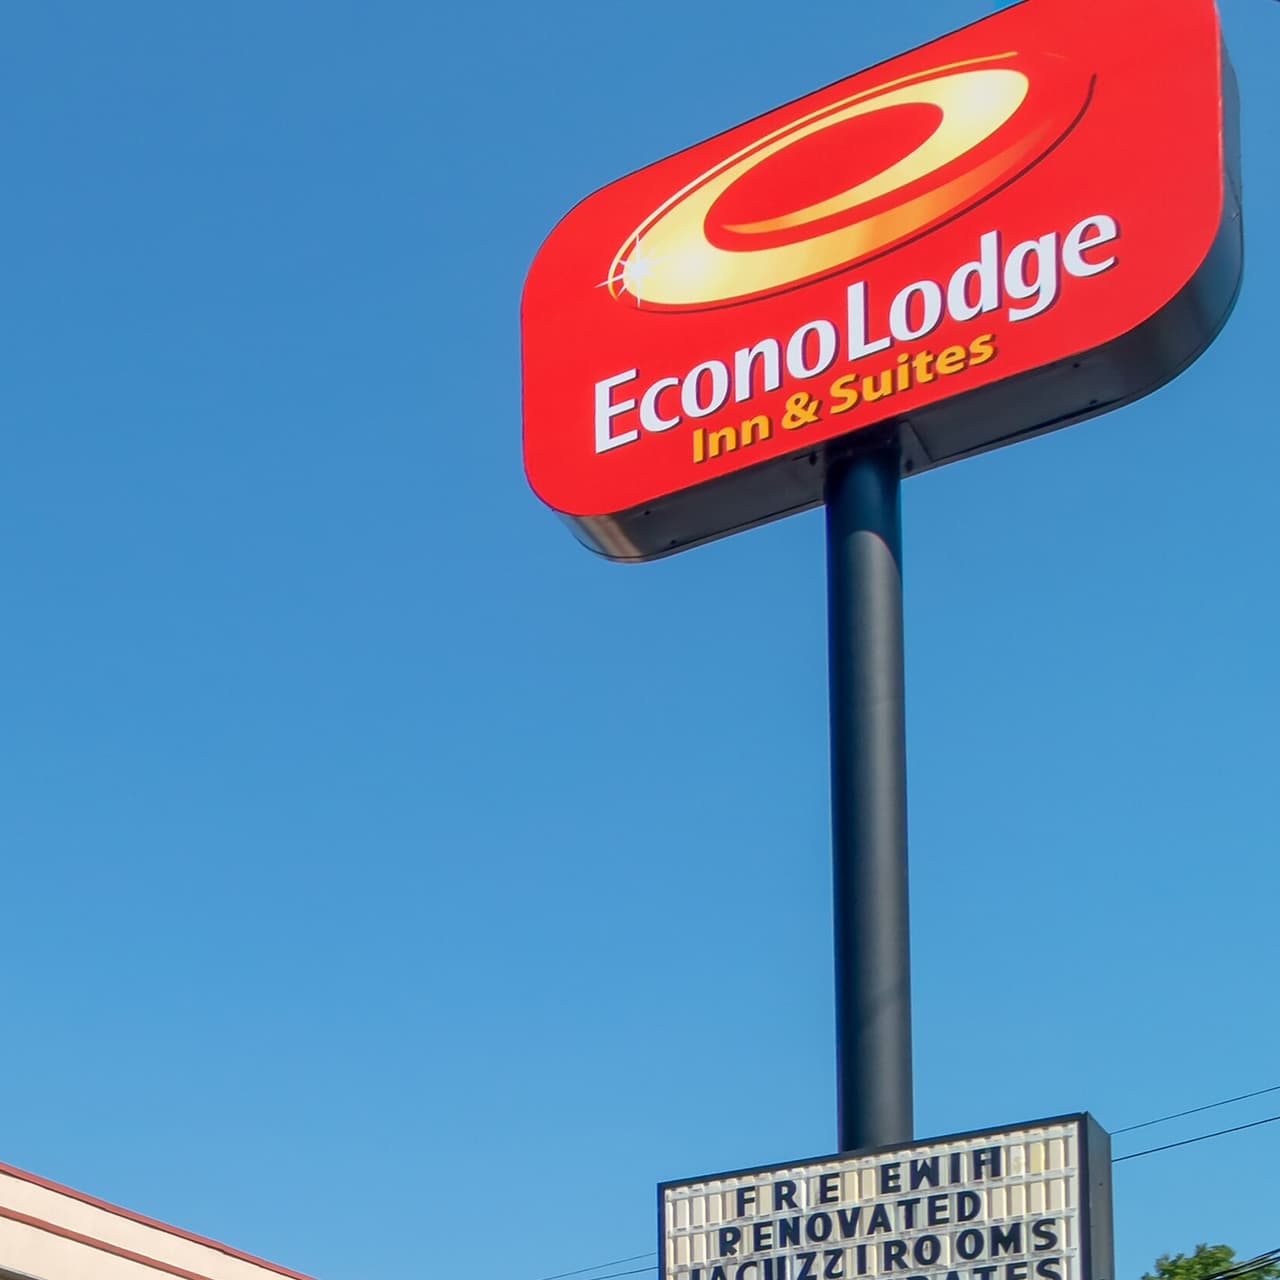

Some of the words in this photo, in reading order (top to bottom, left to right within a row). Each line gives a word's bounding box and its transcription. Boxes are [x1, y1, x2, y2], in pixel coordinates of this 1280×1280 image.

[592, 213, 1120, 455] EconoLodge
[692, 413, 771, 464] Inn
[781, 393, 819, 431] &
[828, 333, 997, 416] Suites
[718, 1190, 982, 1258] RENOVATED
[884, 1217, 1059, 1273] ROOMS
